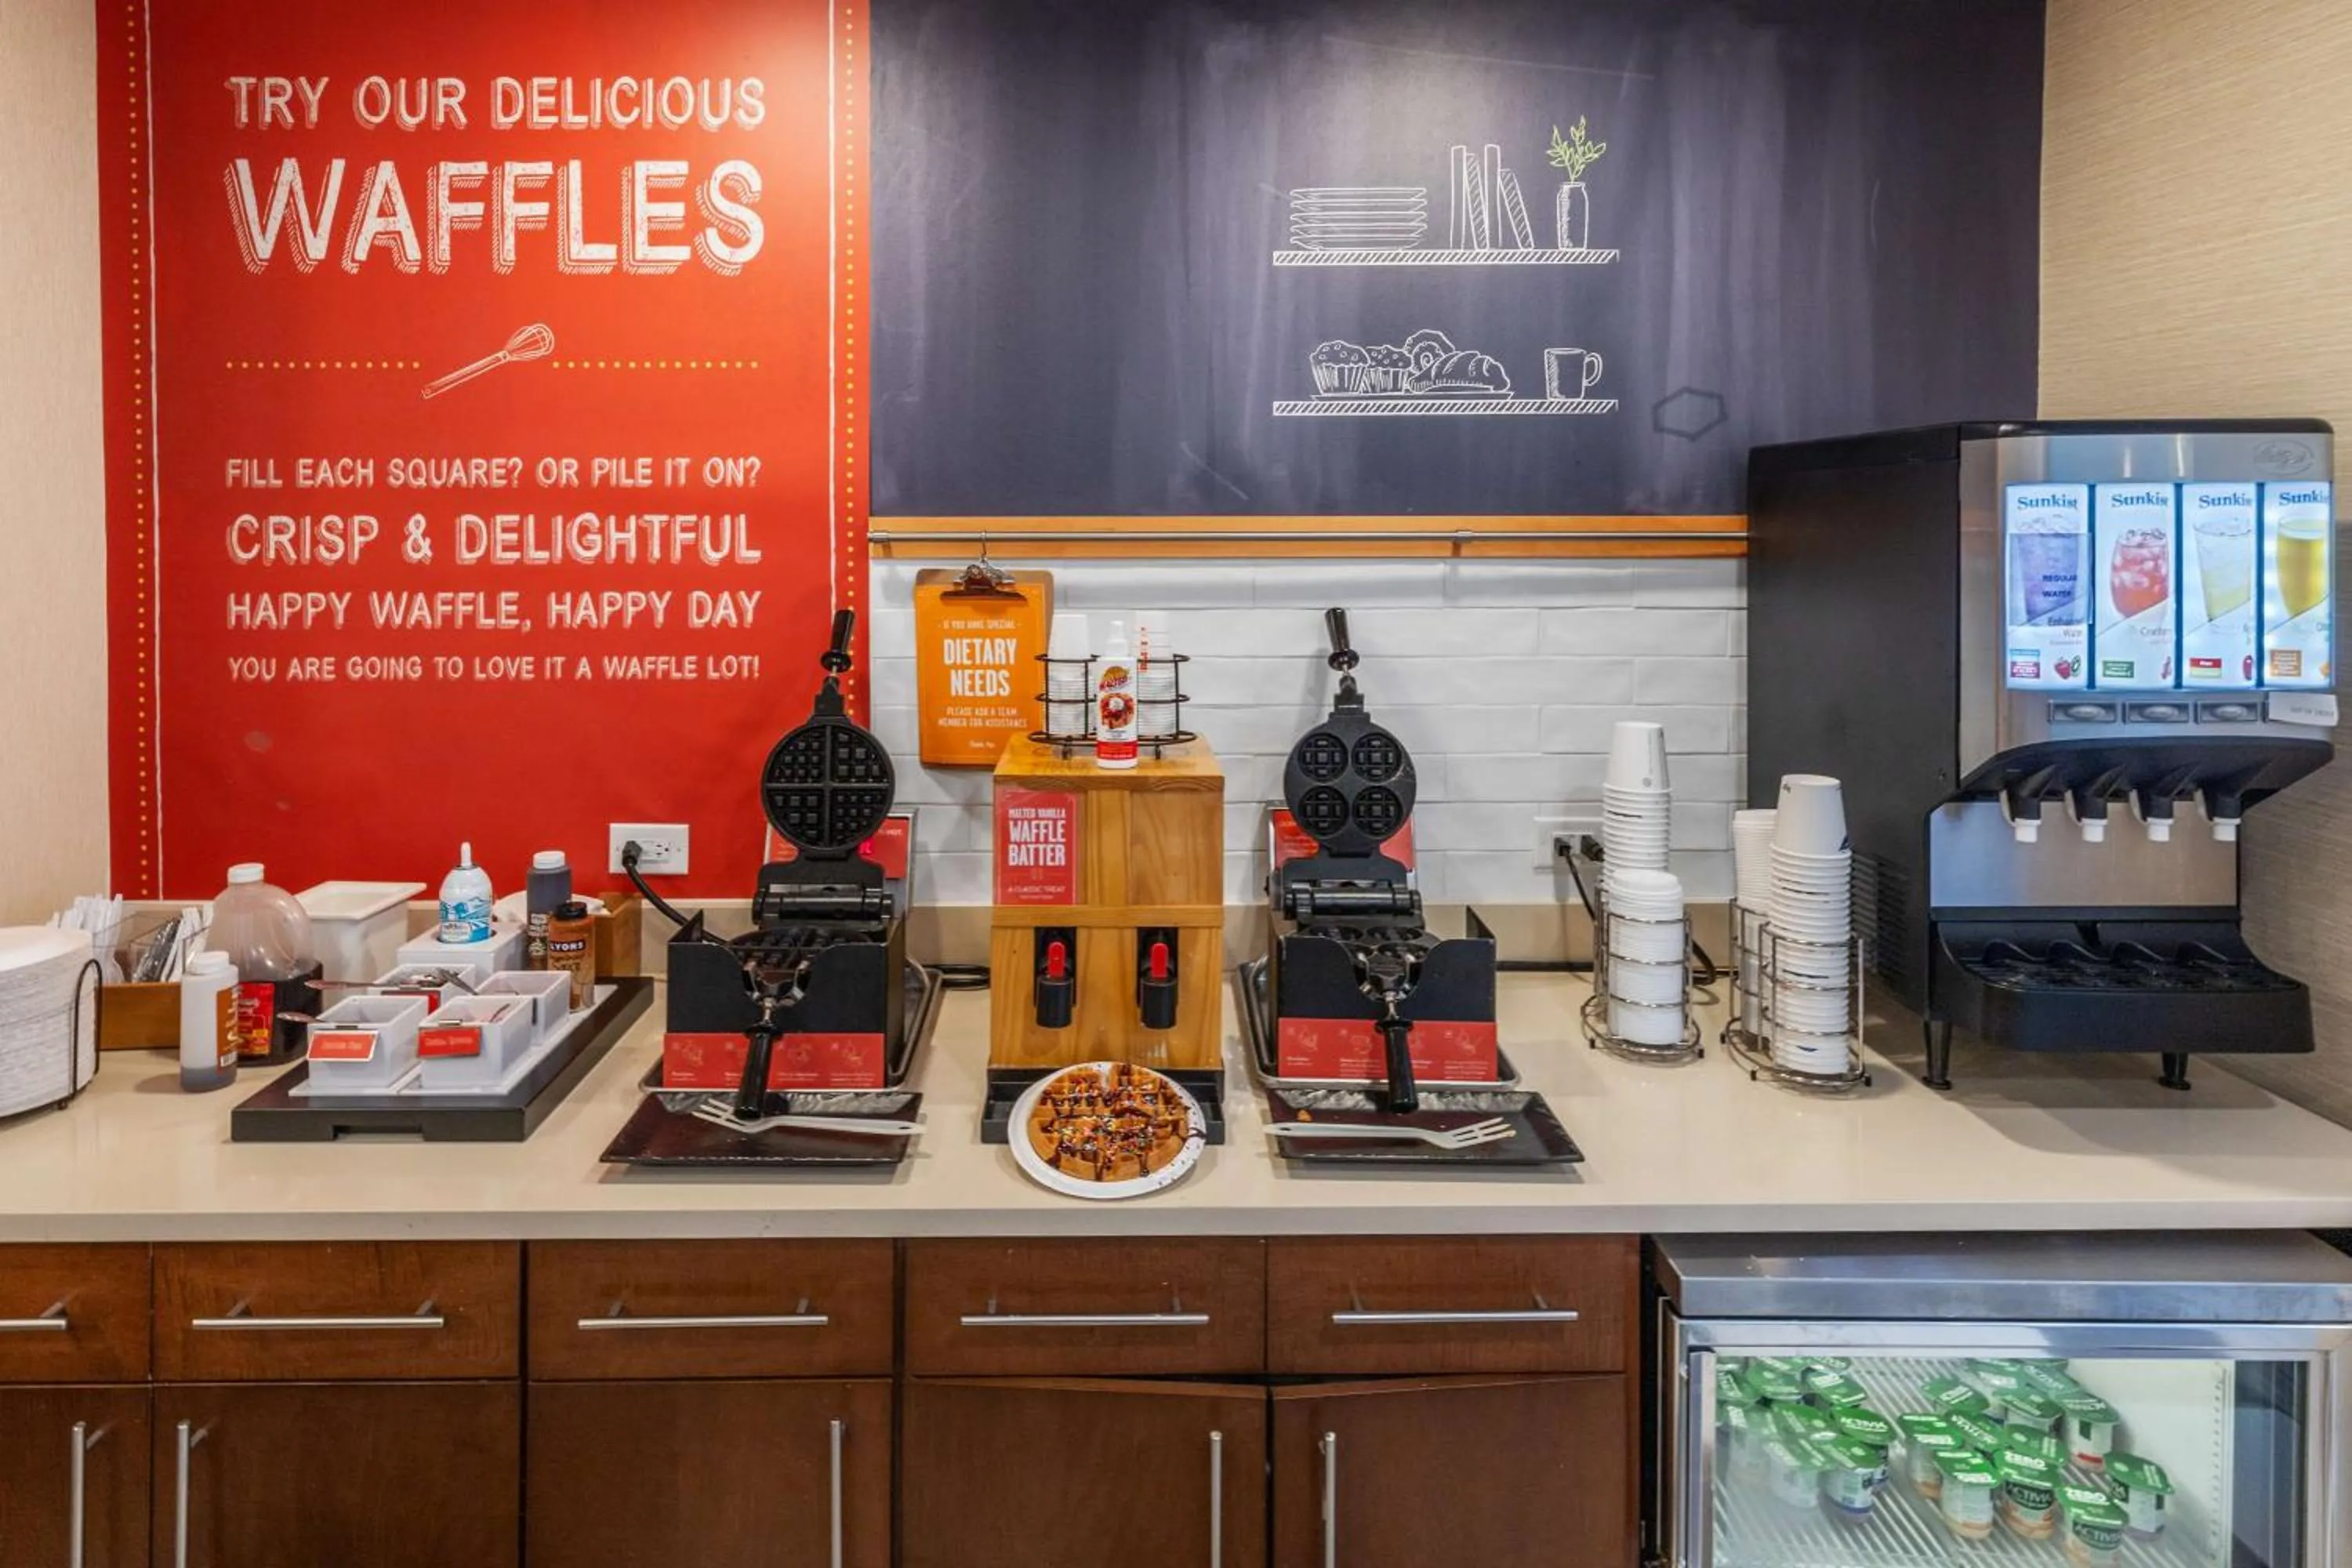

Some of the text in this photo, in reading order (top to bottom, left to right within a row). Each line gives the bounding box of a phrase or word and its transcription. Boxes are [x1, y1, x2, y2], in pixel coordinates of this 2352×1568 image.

[225, 75, 767, 132] TRY OUR DELICIOUS
[223, 157, 766, 276] WAFFLES
[227, 457, 761, 489] FILL EACH SQUARE? OR PILE IT ON?
[226, 513, 762, 565] CRISP & DELIGHTFUL
[227, 591, 762, 633] HAPPY WAFFLE, HAPPY DAY
[943, 637, 1018, 666] DIETARY
[227, 655, 760, 681] YOU ARE GOING TO LOVE IT A WAFFLE LOT!
[950, 669, 1011, 697] NEEDS
[1009, 819, 1066, 843] WAFFLE
[1008, 844, 1065, 866] BATTER
